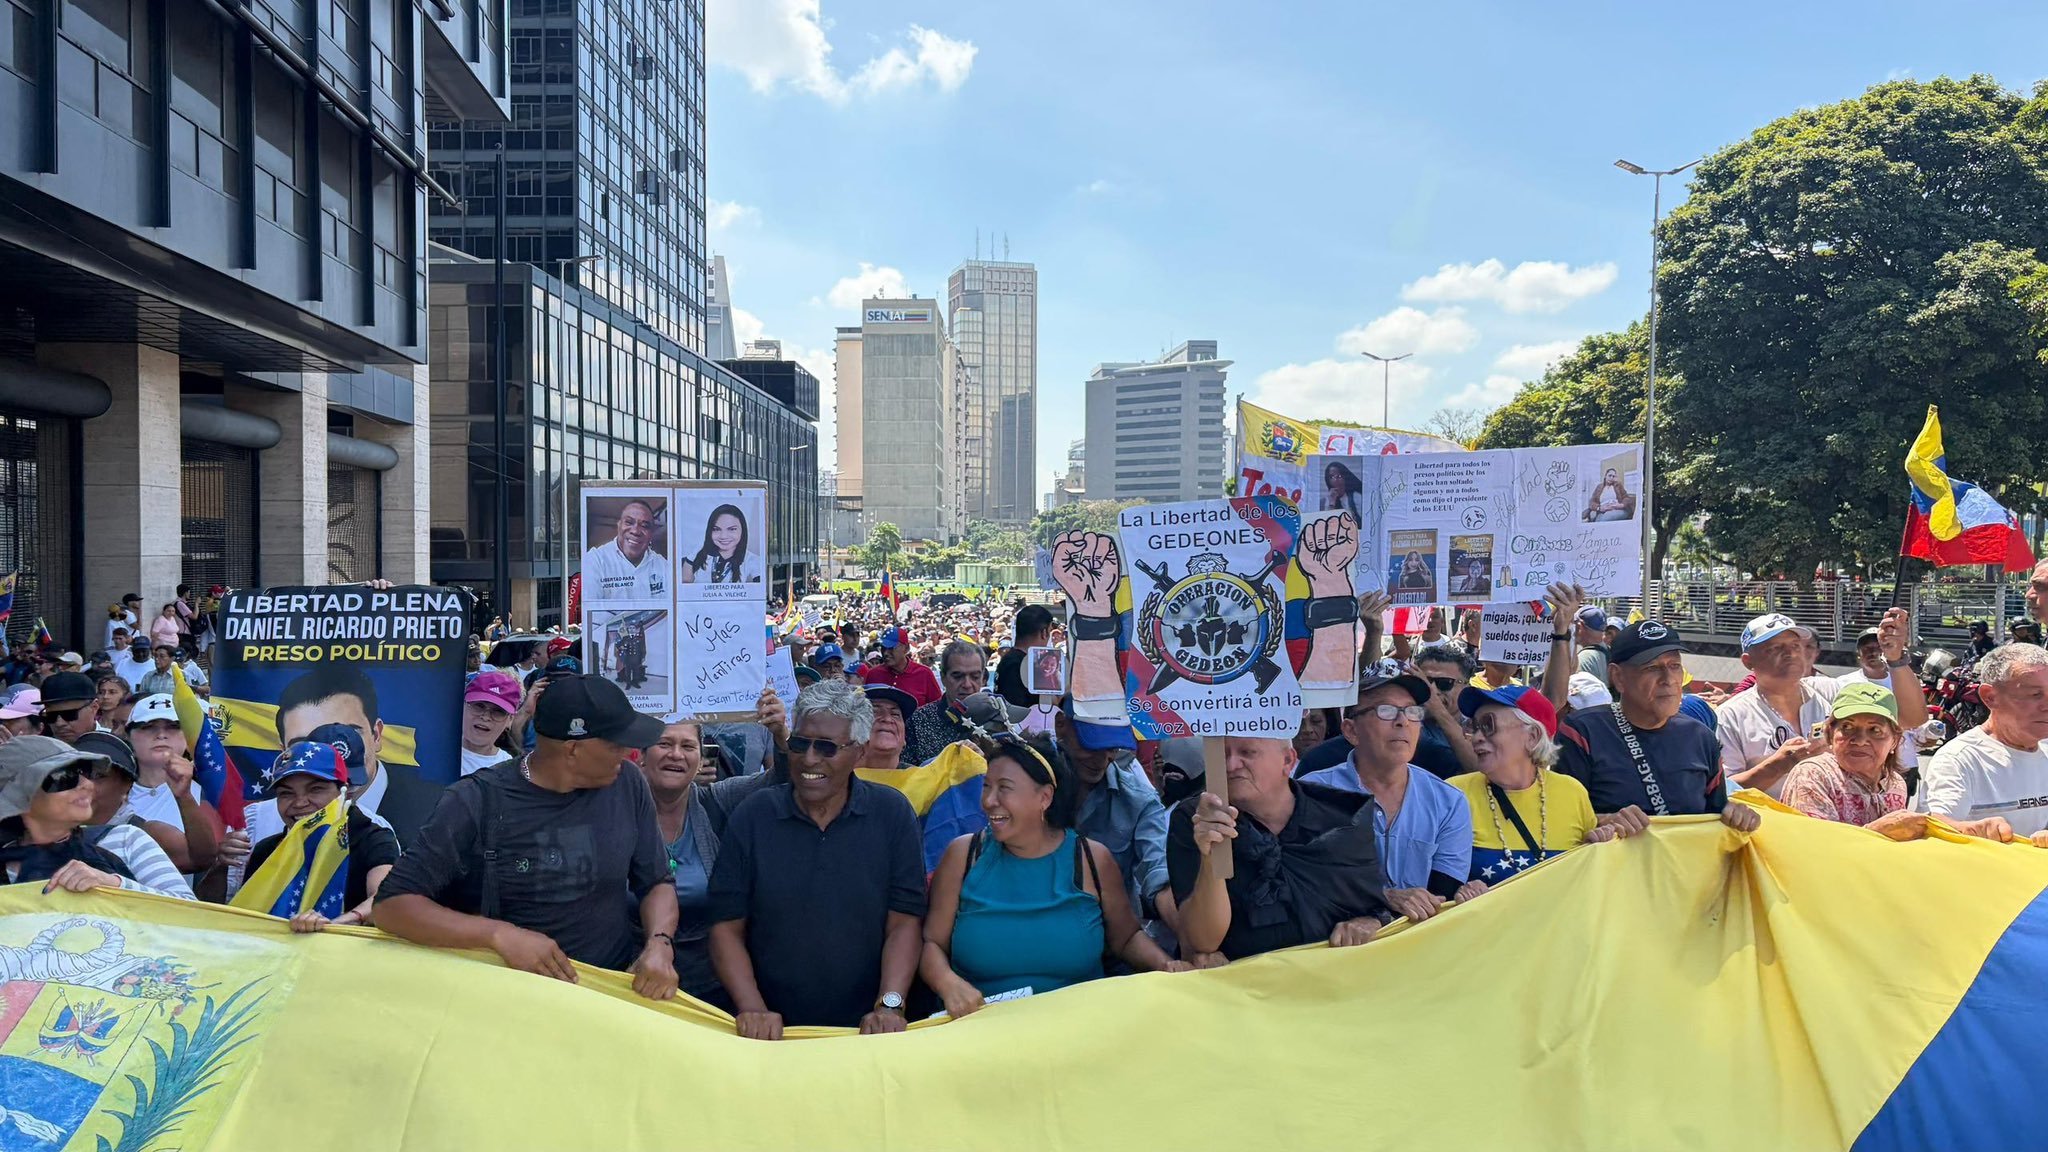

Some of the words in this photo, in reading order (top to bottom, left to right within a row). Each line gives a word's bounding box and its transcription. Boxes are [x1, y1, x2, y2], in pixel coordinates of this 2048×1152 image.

[867, 310, 906, 321] SENIAT
[1413, 488, 1438, 496] algunos
[1454, 495, 1488, 504] presidente
[1121, 513, 1143, 528] La
[1150, 505, 1231, 526] Libertad
[1238, 504, 1262, 520] de
[1268, 502, 1299, 518] los
[1148, 528, 1271, 550] GEDEONES.
[229, 594, 363, 614] LIBERTAD
[371, 593, 463, 612] PLENA
[1168, 582, 1254, 614] OPERACION
[225, 617, 296, 640] DANIEL
[302, 616, 386, 640] RICARDO
[392, 616, 462, 639] PRIETO
[1483, 611, 1521, 625] migajas,
[1485, 630, 1520, 641] sueldos
[1521, 632, 1539, 644] que
[1540, 632, 1552, 643] lle
[242, 644, 323, 662] PRESO
[330, 640, 441, 661] POLÍTICO
[1175, 646, 1247, 672] GEDEON
[1503, 649, 1516, 660] las
[1129, 697, 1152, 712] Se
[1158, 693, 1252, 712] convertirá
[1259, 696, 1281, 708] en
[1287, 692, 1302, 706] la
[1151, 722, 1184, 734] voz
[1190, 718, 1218, 733] del
[1624, 734, 1645, 760] 1980
